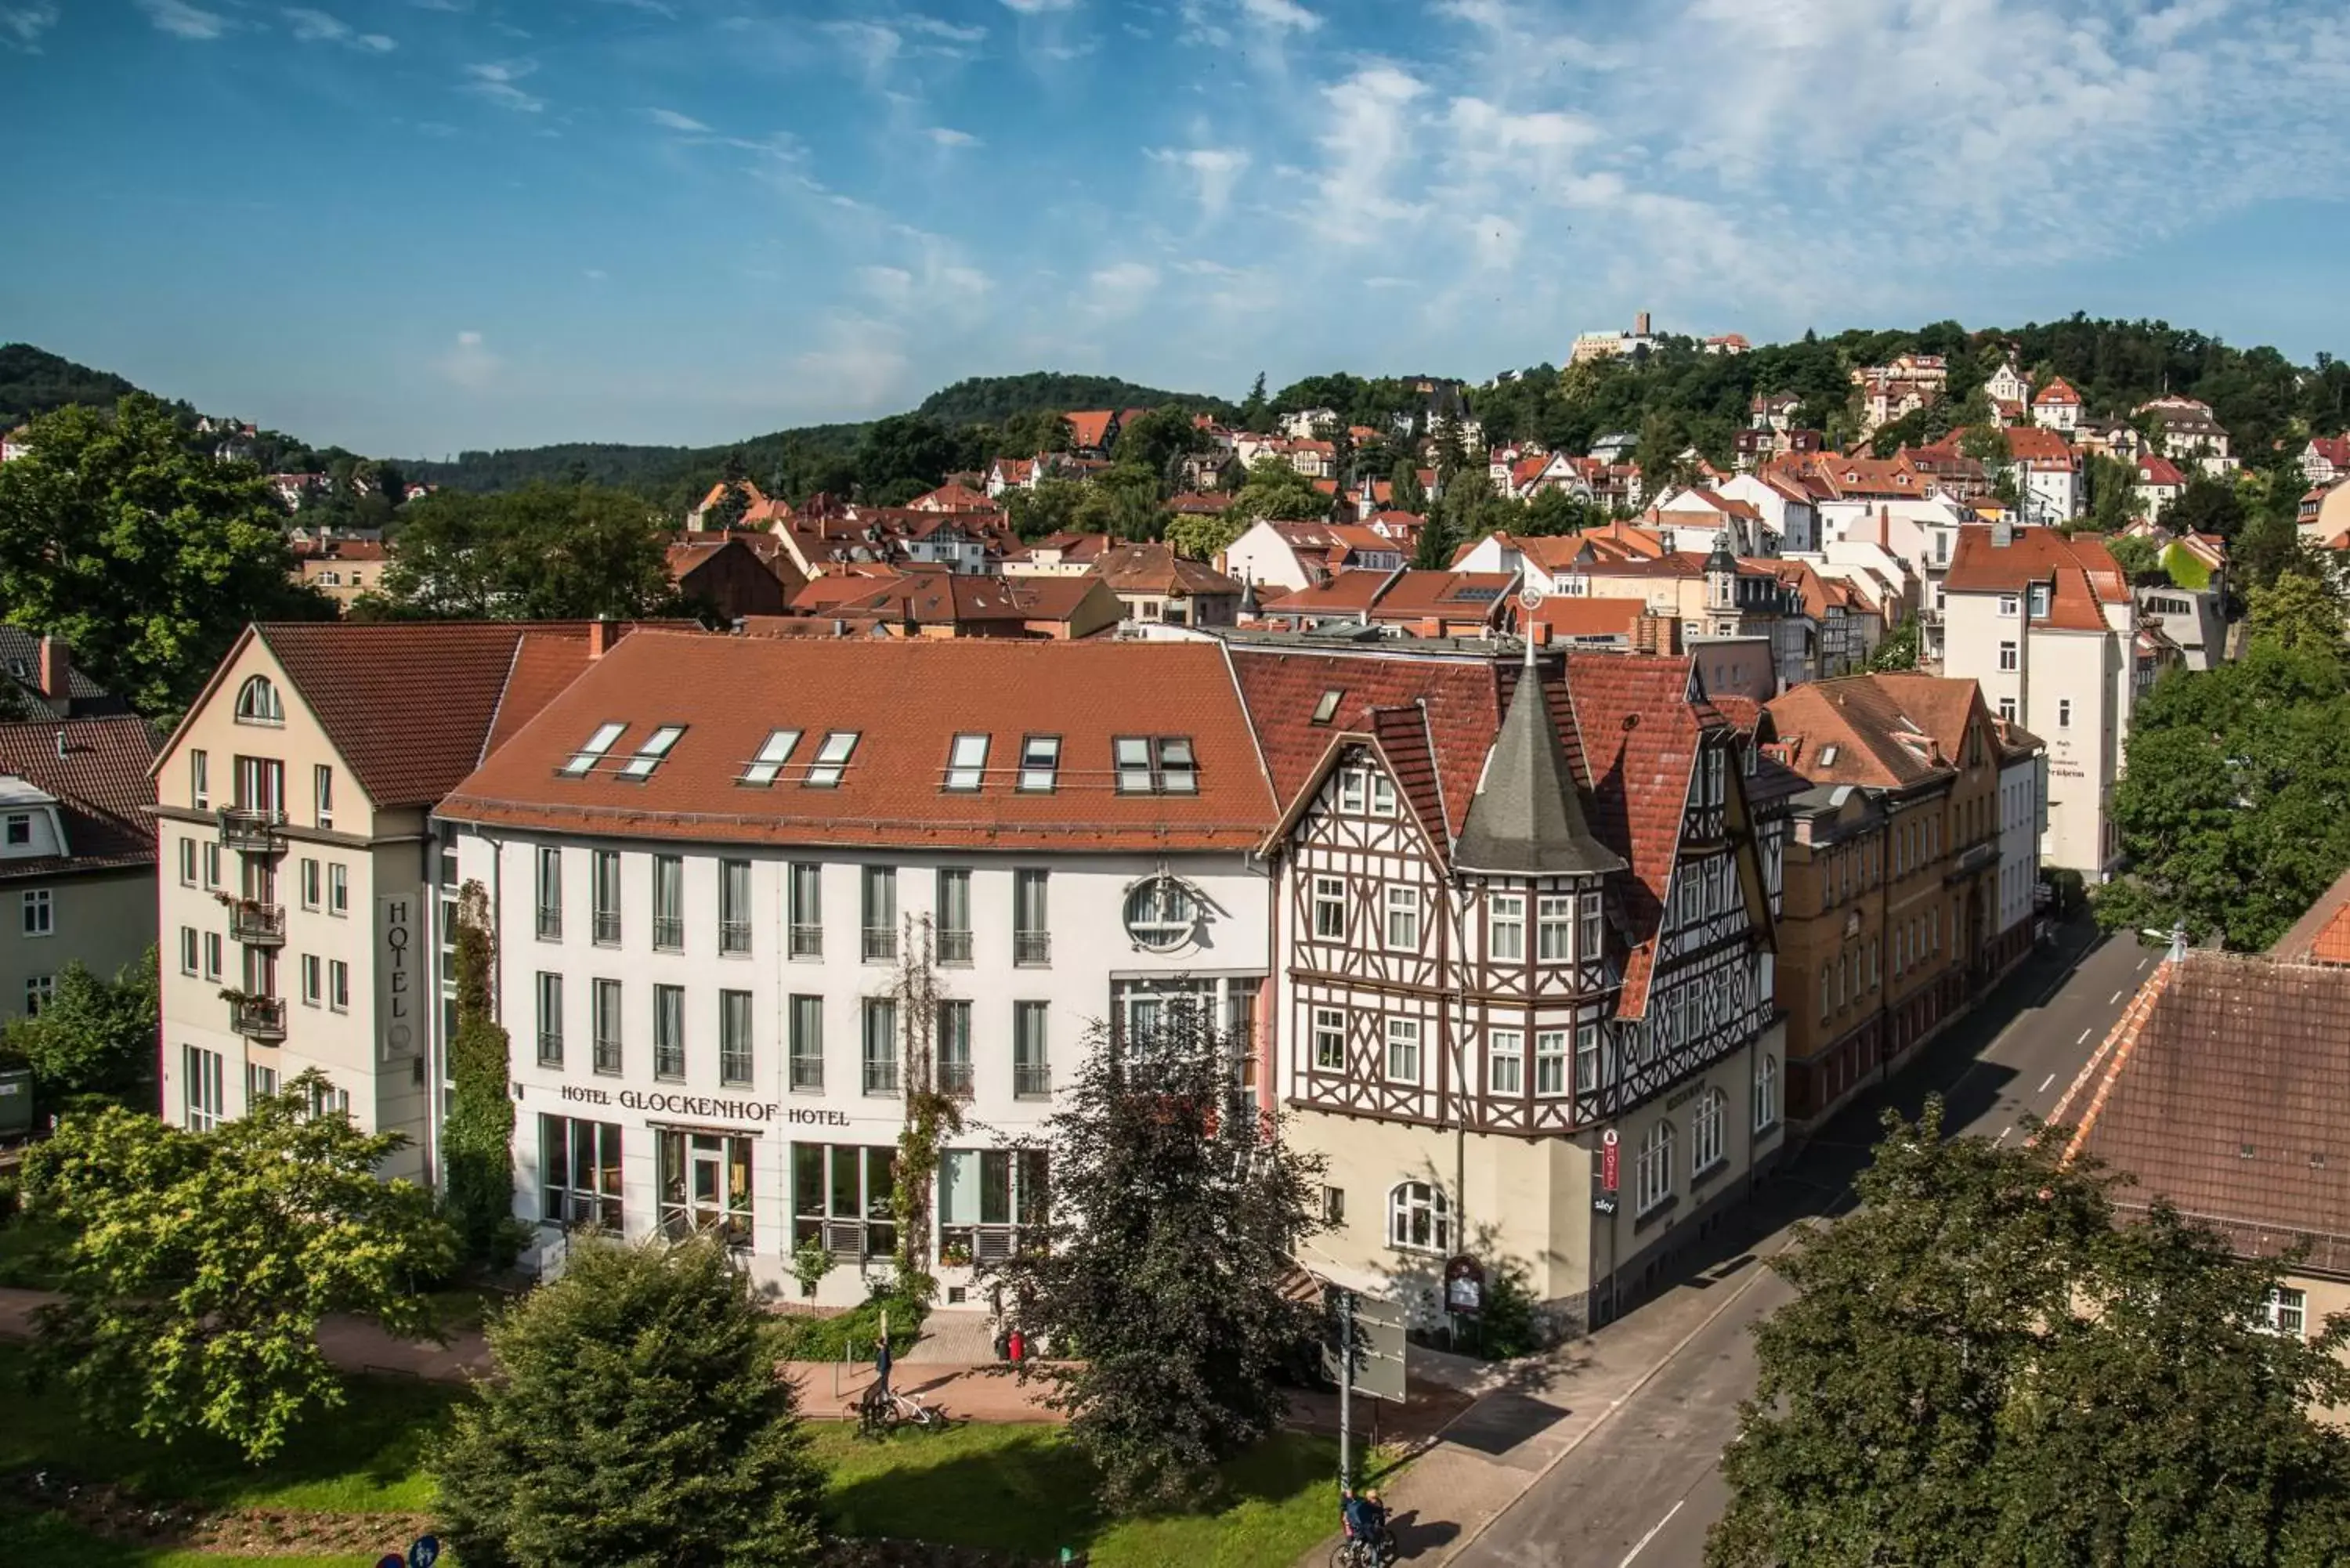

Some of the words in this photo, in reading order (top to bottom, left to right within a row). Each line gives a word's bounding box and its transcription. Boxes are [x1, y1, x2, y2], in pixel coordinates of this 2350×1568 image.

[388, 901, 408, 1017] HOTEL
[562, 1085, 611, 1105] HOTEL
[620, 1090, 779, 1122] GLOCKENHOF
[789, 1108, 850, 1126] HOTEL
[1595, 1199, 1614, 1213] sky
